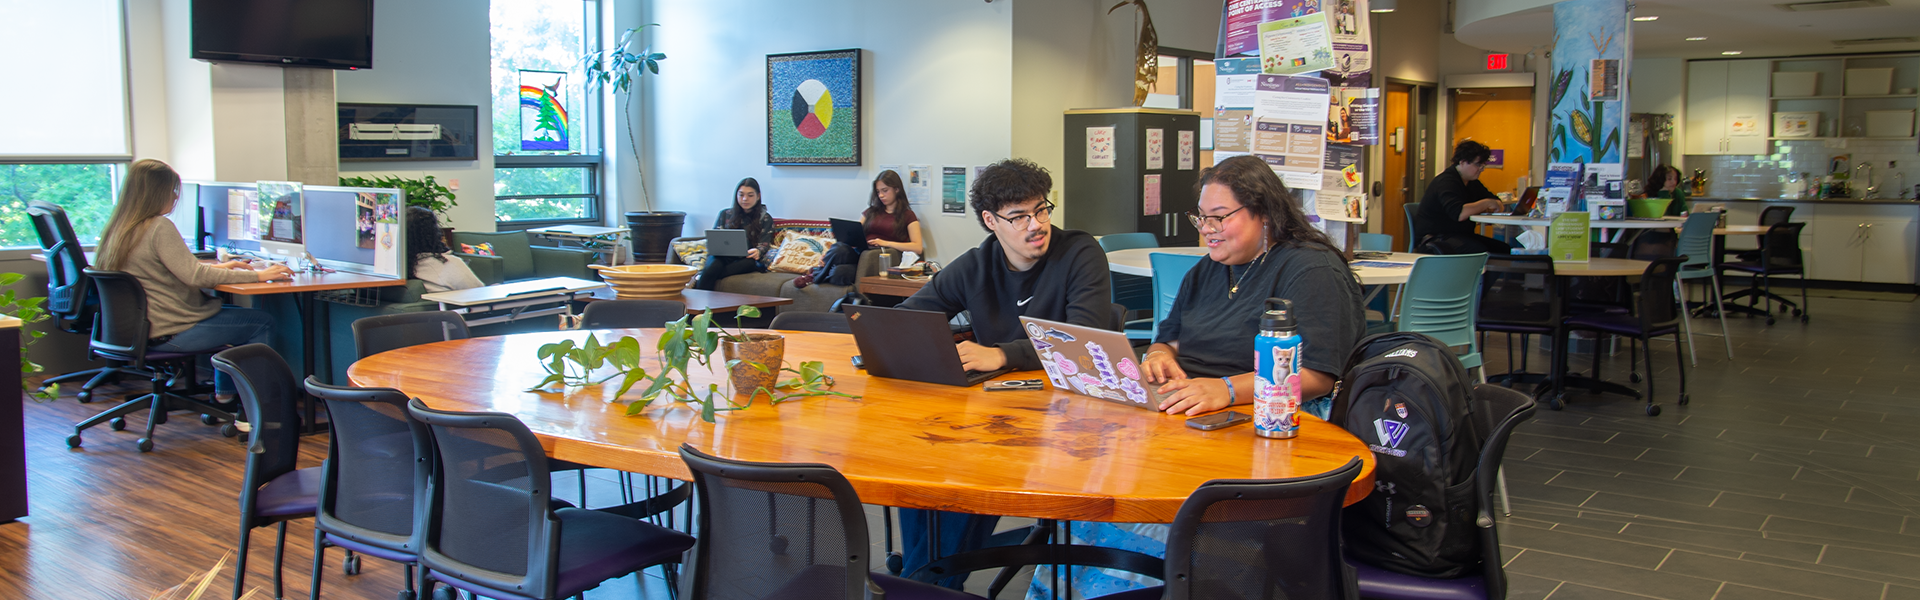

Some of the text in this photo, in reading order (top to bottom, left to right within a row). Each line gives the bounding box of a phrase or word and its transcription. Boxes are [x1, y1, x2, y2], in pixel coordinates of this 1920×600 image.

[1228, 8, 1244, 17] POINT
[1254, 0, 1283, 10] ACCESS
[1487, 53, 1508, 70] EXIT
[787, 253, 818, 267] thank
